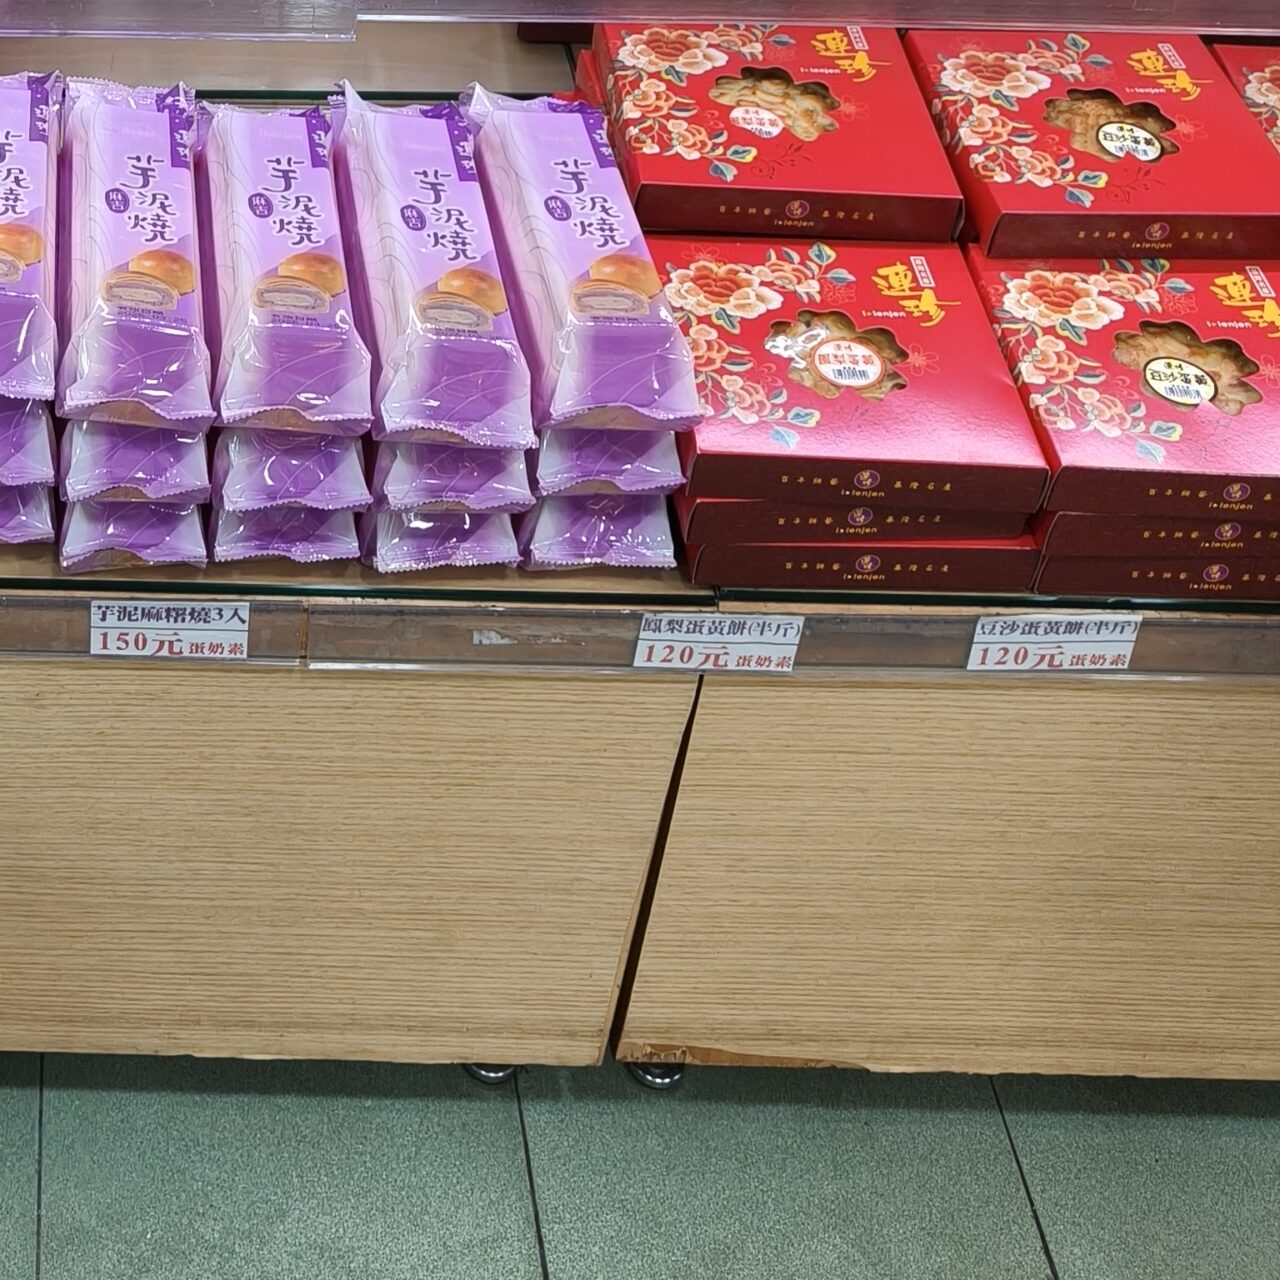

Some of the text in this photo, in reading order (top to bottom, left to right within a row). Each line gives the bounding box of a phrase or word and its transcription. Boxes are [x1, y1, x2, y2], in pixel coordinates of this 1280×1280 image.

[120, 155, 178, 243] 芋泥燒
[262, 156, 323, 246] 芋泥燒
[413, 168, 480, 262] 芋泥燒
[553, 157, 622, 248] 芋泥燒
[98, 631, 246, 657] 150元 蛋奶素
[642, 643, 794, 670] 120元 蛋奶素
[976, 620, 1139, 637] 豆沙蛋黃餅(半斤)
[976, 645, 1128, 669] 120元 蛋奶素
